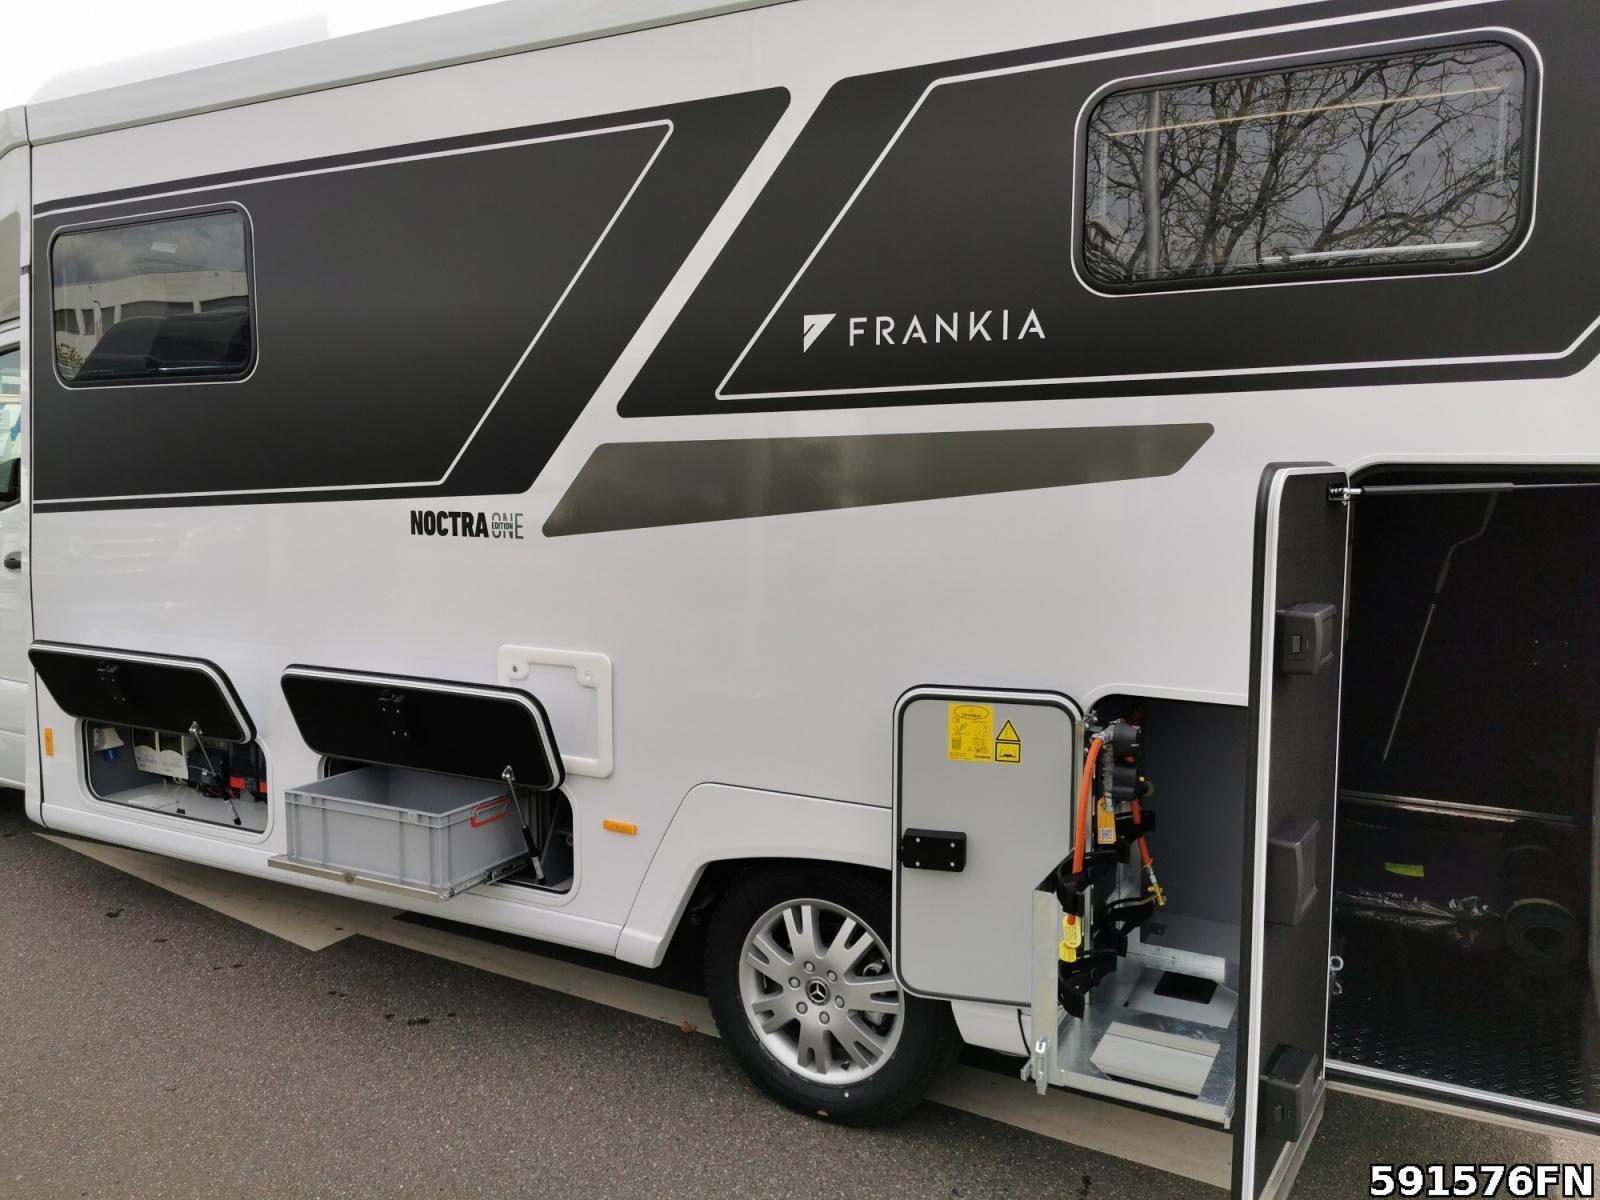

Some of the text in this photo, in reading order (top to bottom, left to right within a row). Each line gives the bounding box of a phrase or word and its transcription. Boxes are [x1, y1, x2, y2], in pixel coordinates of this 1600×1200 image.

[849, 308, 1046, 347] FRANKIA
[410, 510, 524, 539] NOCTRA ONE
[491, 521, 514, 530] EDITION
